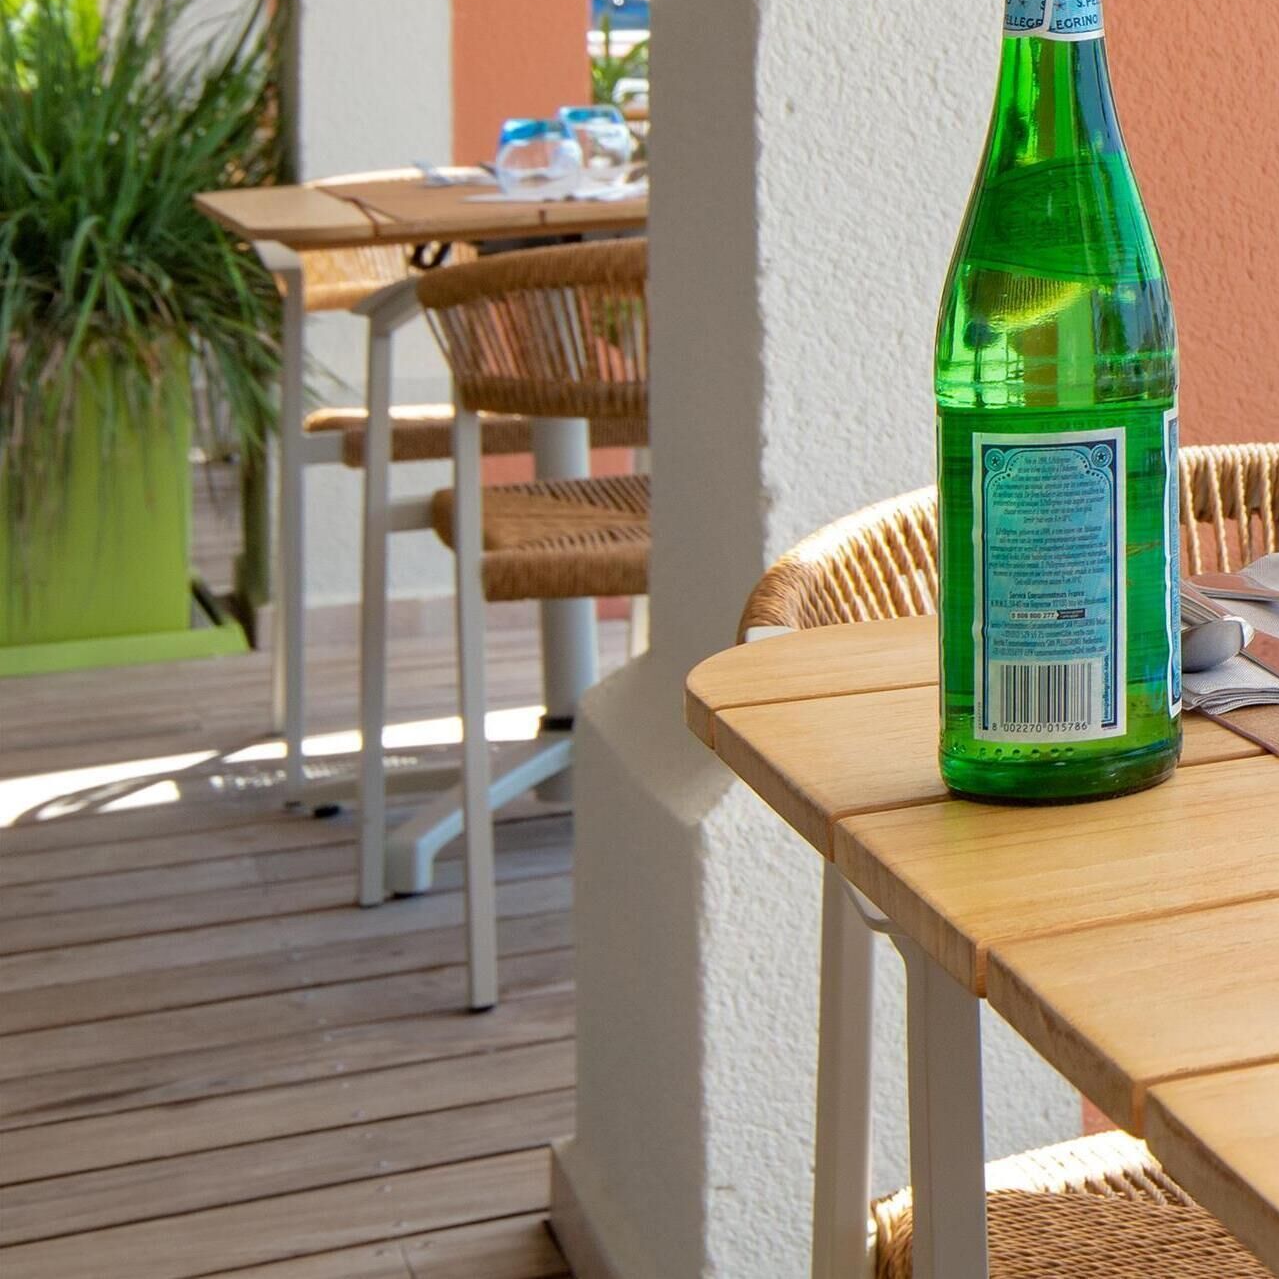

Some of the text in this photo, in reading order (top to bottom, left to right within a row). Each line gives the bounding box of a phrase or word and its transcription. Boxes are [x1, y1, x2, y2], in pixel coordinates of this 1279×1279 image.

[991, 721, 1088, 733] 8 002270 015786
